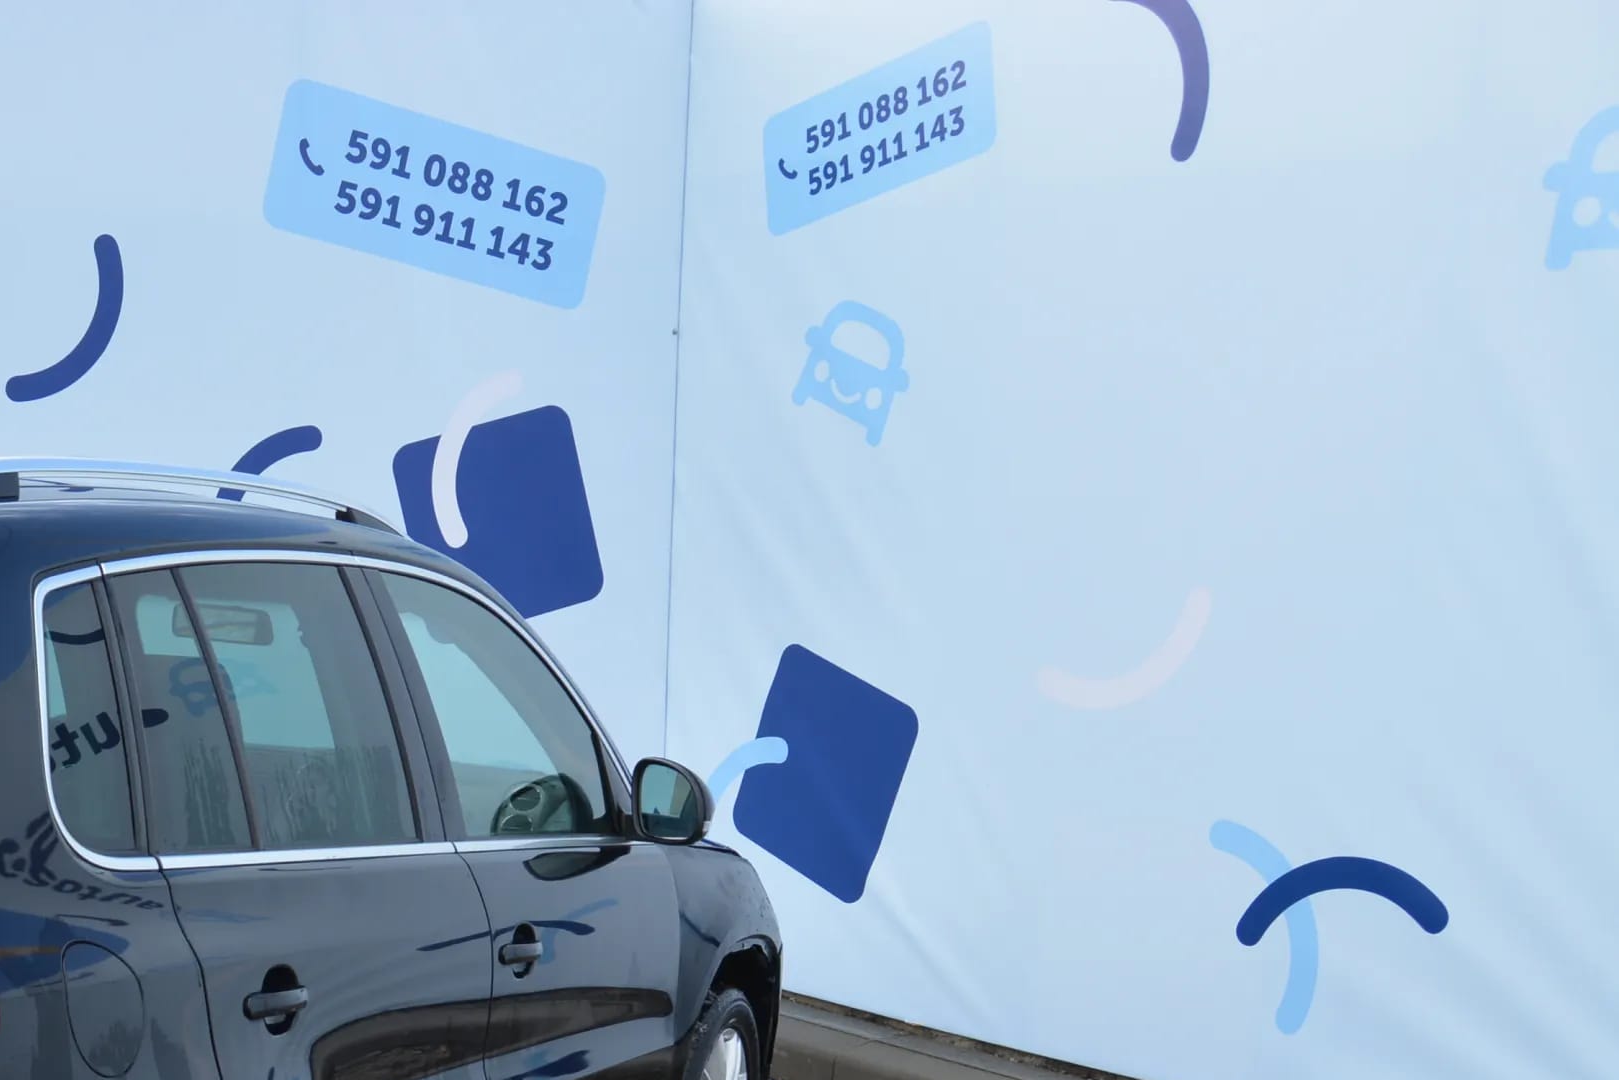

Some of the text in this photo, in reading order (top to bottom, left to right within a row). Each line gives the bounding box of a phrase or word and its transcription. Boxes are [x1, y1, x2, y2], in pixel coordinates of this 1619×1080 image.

[806, 60, 966, 154] 591 088 162
[808, 105, 965, 196] 591 911 143
[344, 129, 568, 225] 591 088 162
[334, 180, 554, 271] 591 911 143
